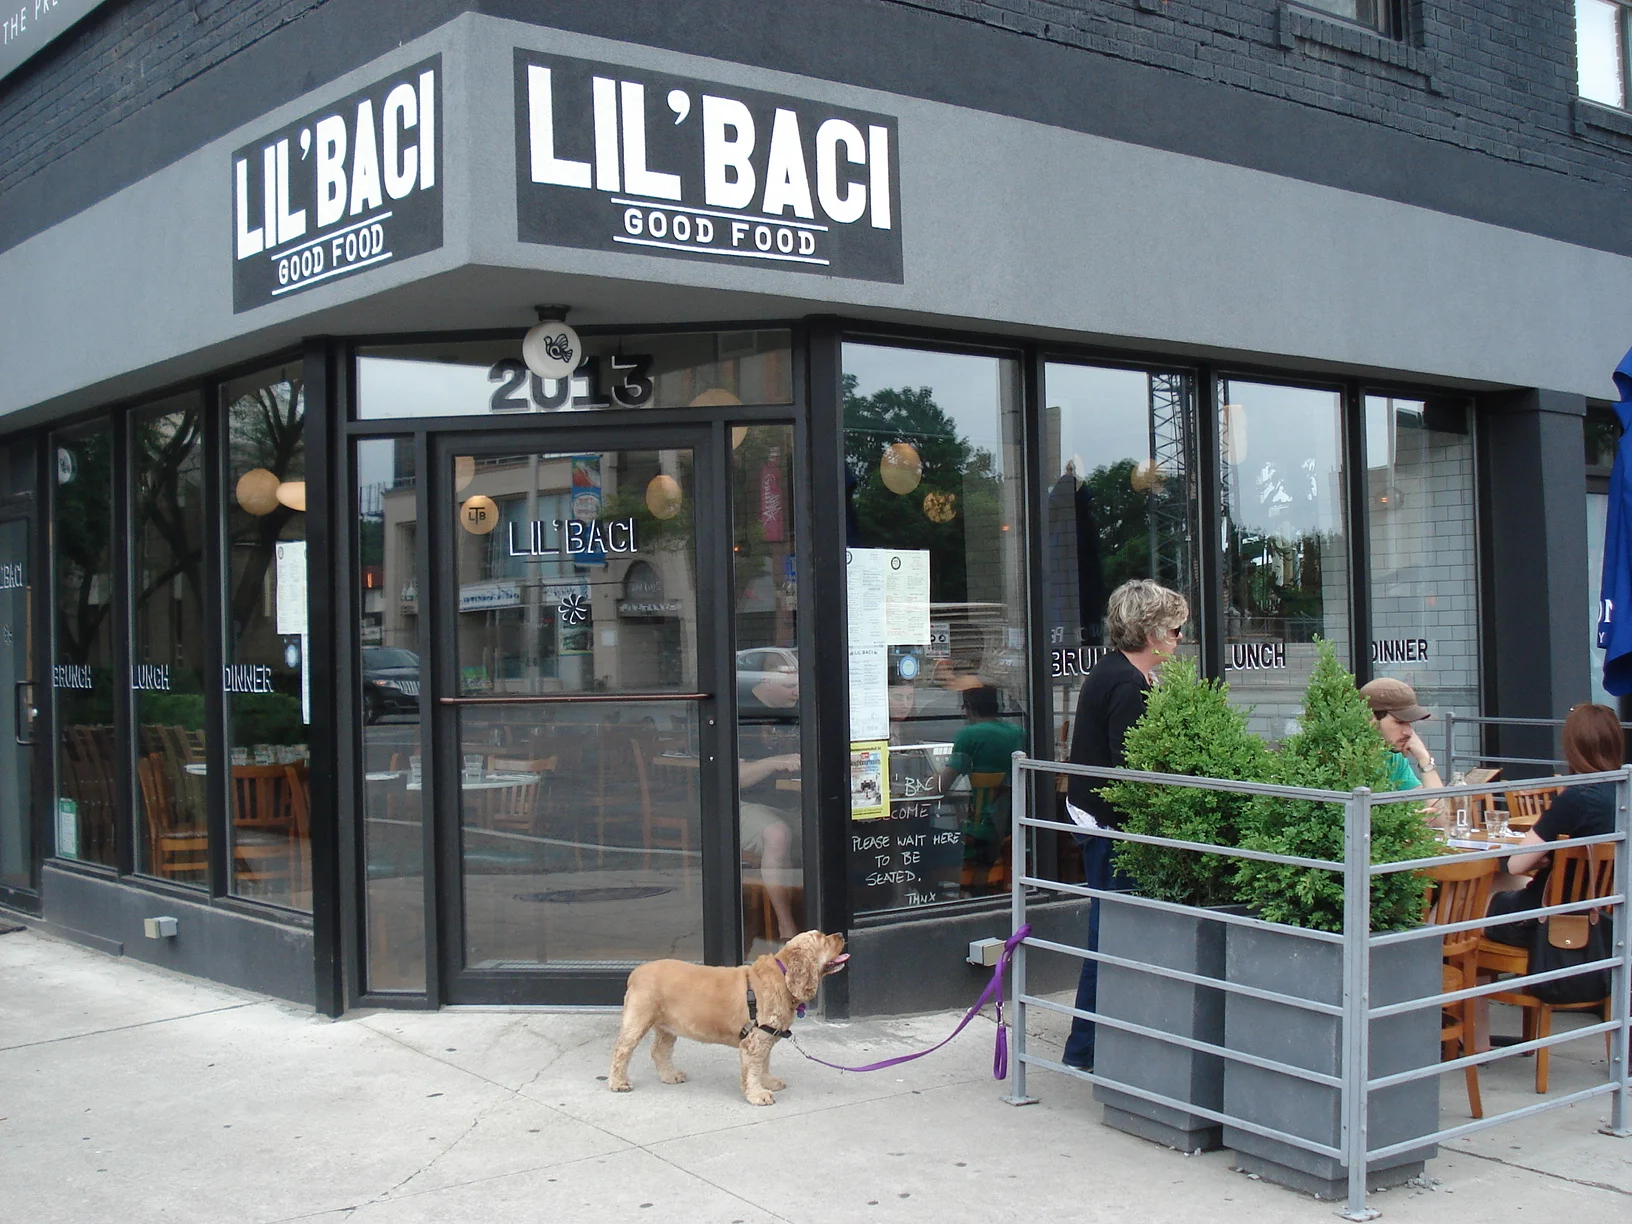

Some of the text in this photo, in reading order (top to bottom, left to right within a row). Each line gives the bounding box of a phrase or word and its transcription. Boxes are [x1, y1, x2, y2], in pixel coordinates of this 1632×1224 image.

[3, 6, 27, 45] THE
[623, 208, 816, 256] GOOD FOOD
[278, 223, 384, 285] GOOD FOOD
[488, 353, 654, 412] 2013
[53, 665, 92, 689] BRUNCH
[131, 664, 170, 691] LUNCH
[223, 664, 274, 693] DINNER
[851, 832, 961, 852] PLEASE WAIT HERE
[875, 851, 920, 868] TO BE
